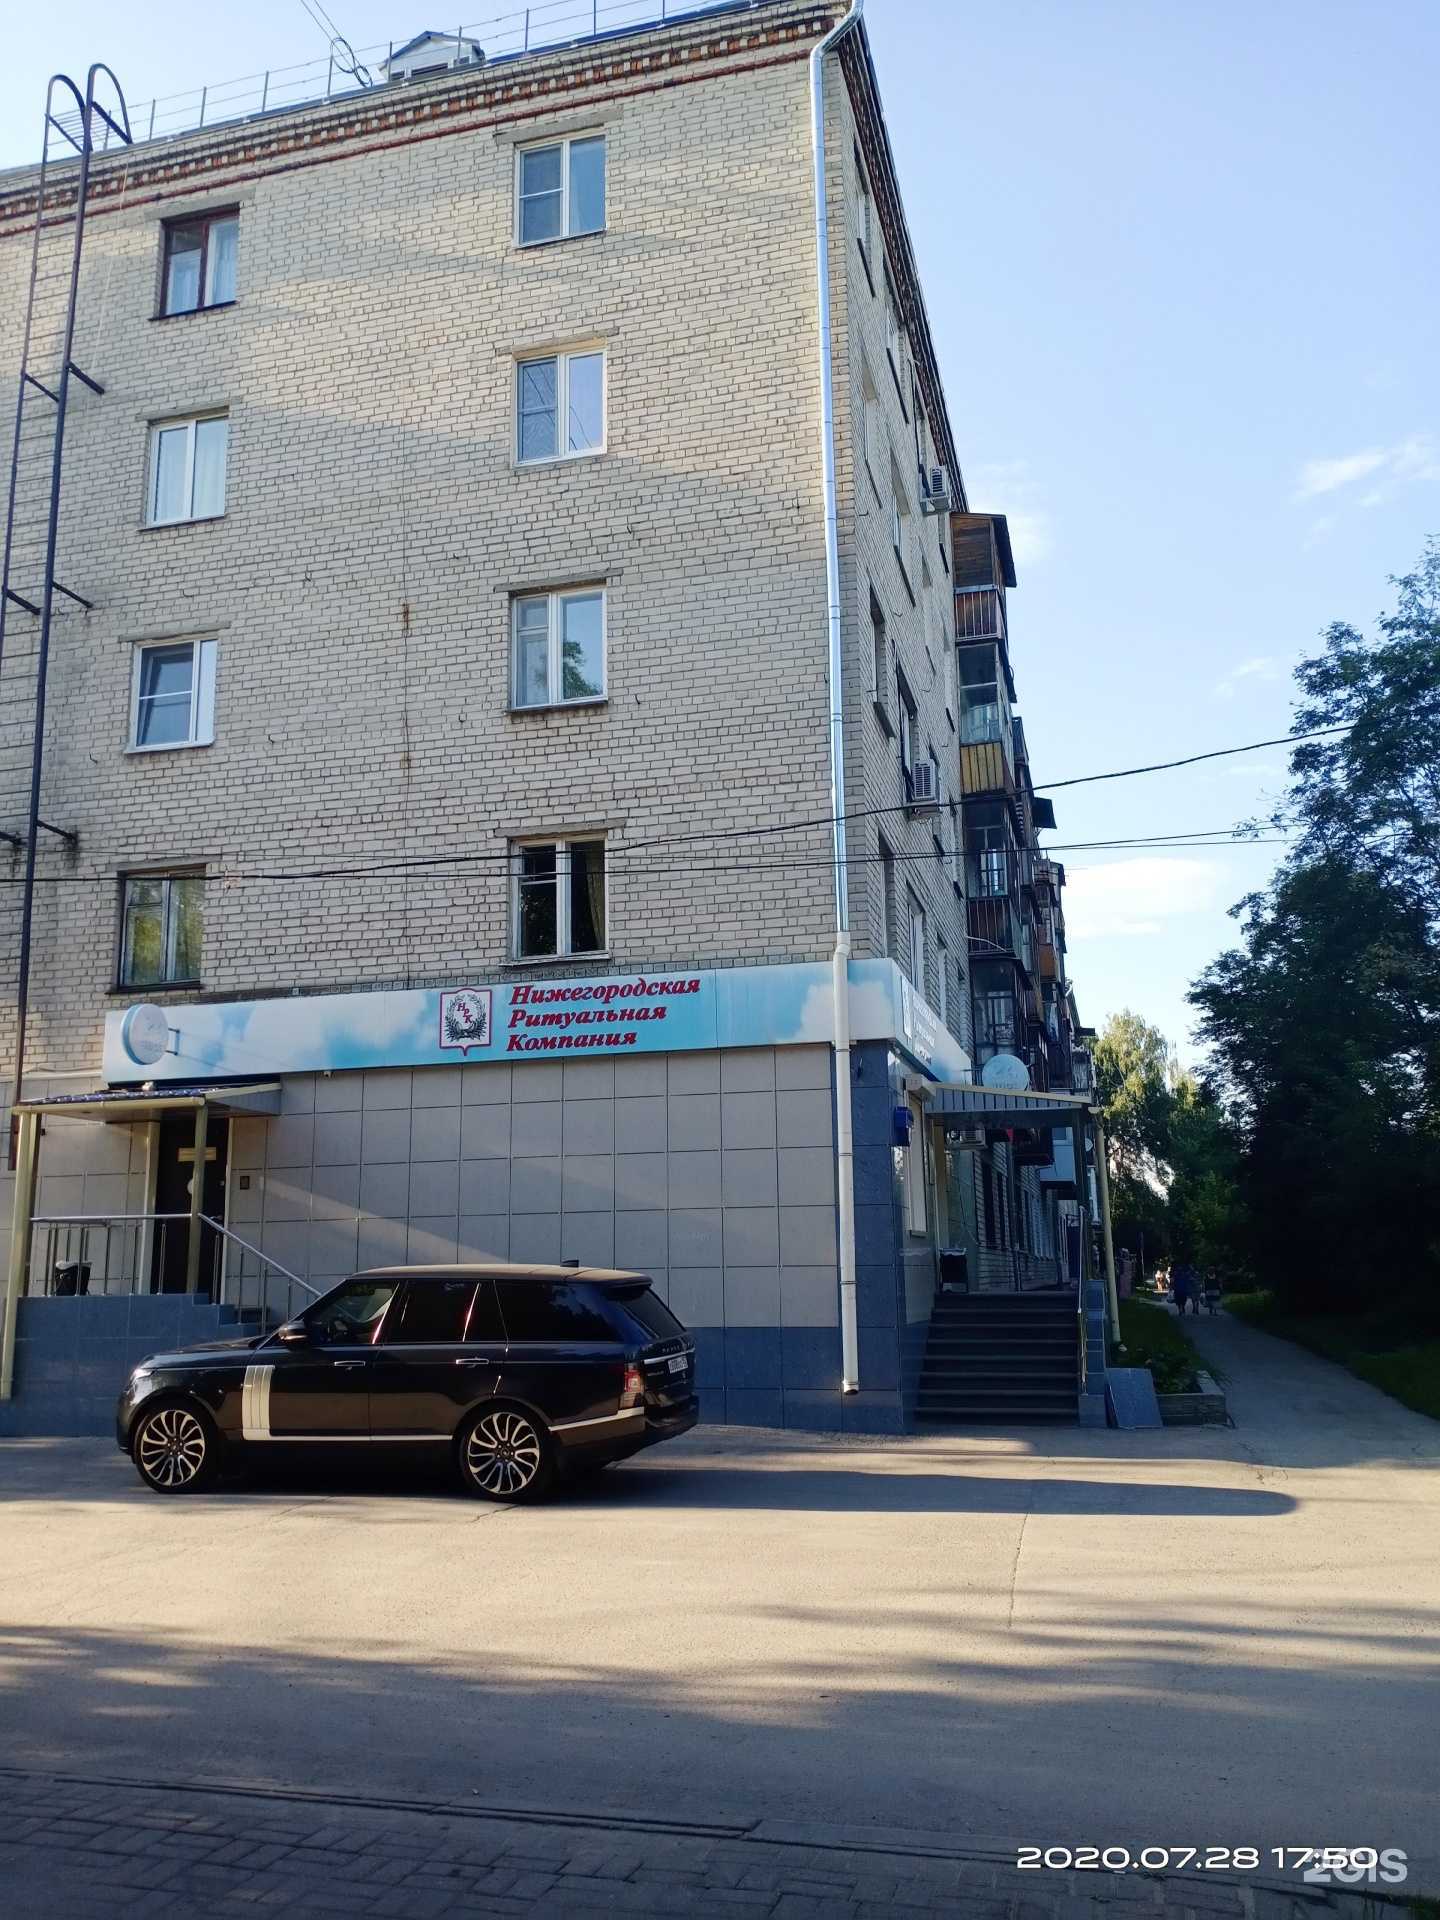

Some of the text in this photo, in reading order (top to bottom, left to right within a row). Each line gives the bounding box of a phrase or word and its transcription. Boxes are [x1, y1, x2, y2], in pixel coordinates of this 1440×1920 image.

[509, 978, 700, 1005] Нижегородская
[508, 1004, 667, 1028] Ритуальная
[506, 1031, 637, 1052] Компания
